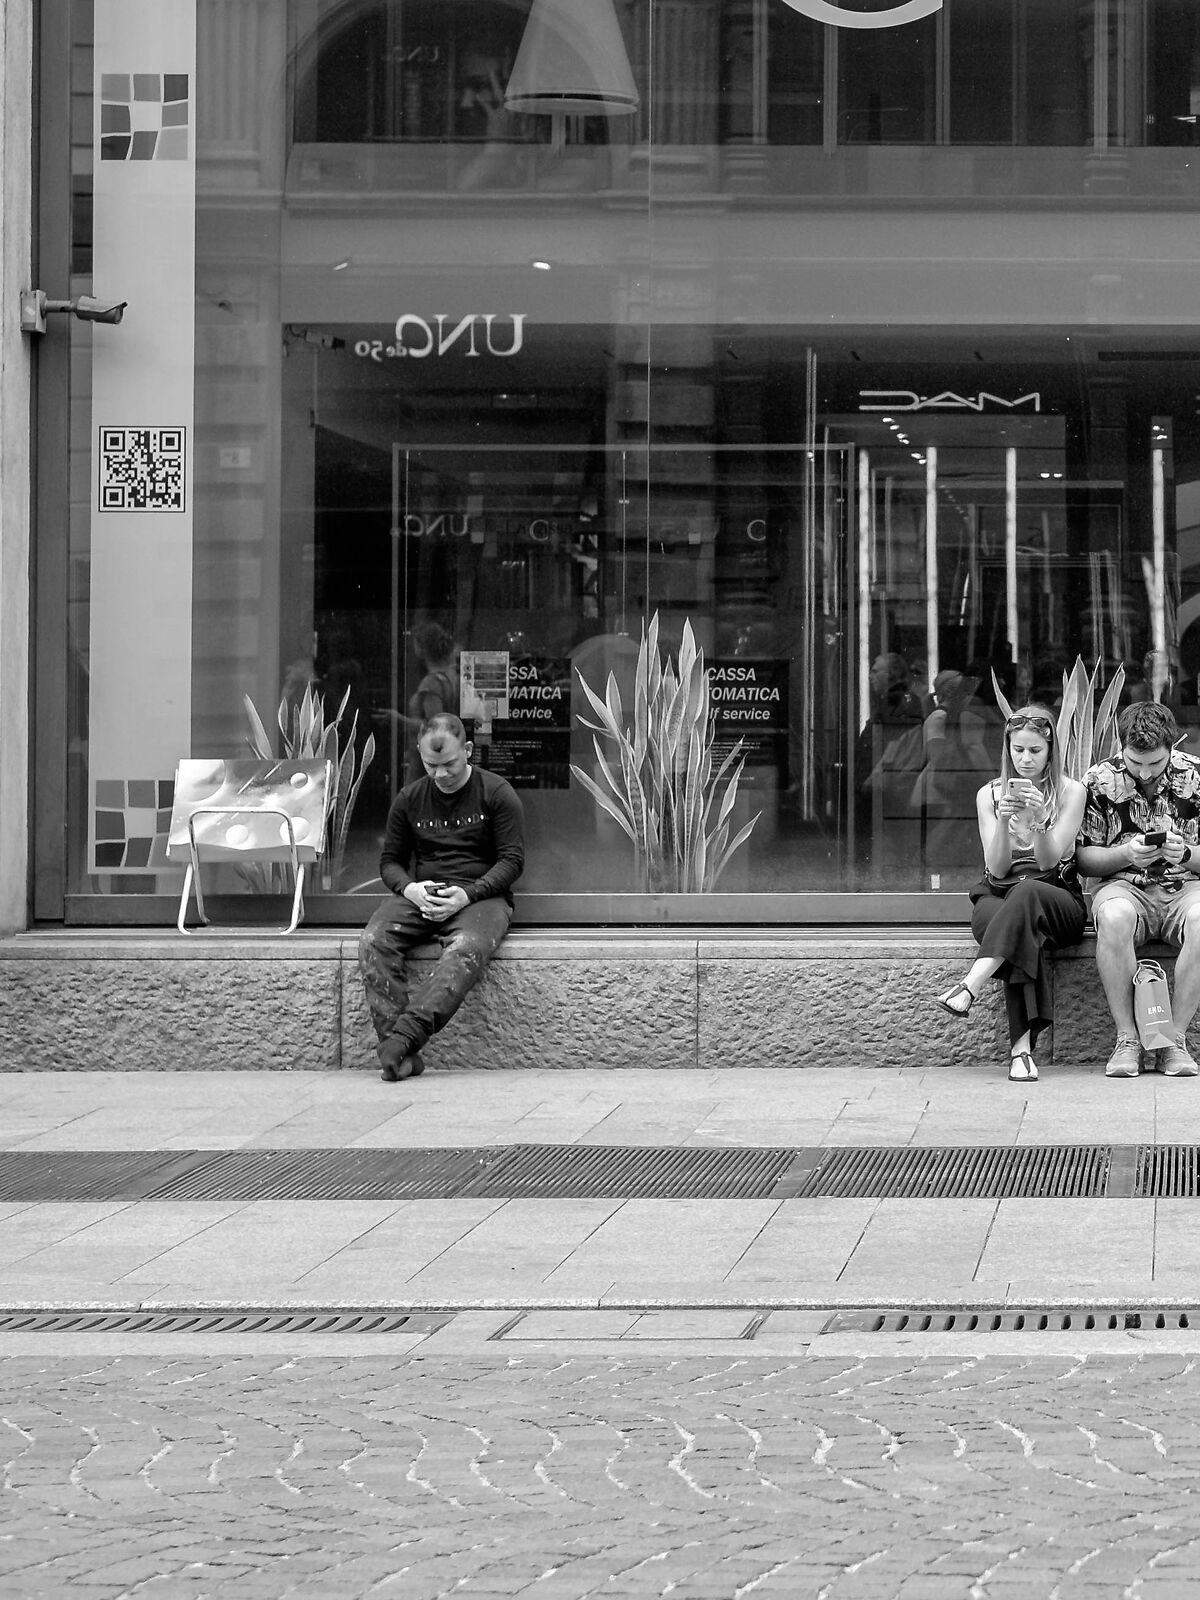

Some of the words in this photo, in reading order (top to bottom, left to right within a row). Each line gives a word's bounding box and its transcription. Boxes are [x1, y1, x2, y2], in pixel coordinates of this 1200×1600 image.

[509, 666, 539, 680] SSA
[707, 667, 757, 681] CASSA
[510, 685, 562, 700] MATICA
[709, 686, 781, 701] OMATICA
[722, 707, 771, 720] service
